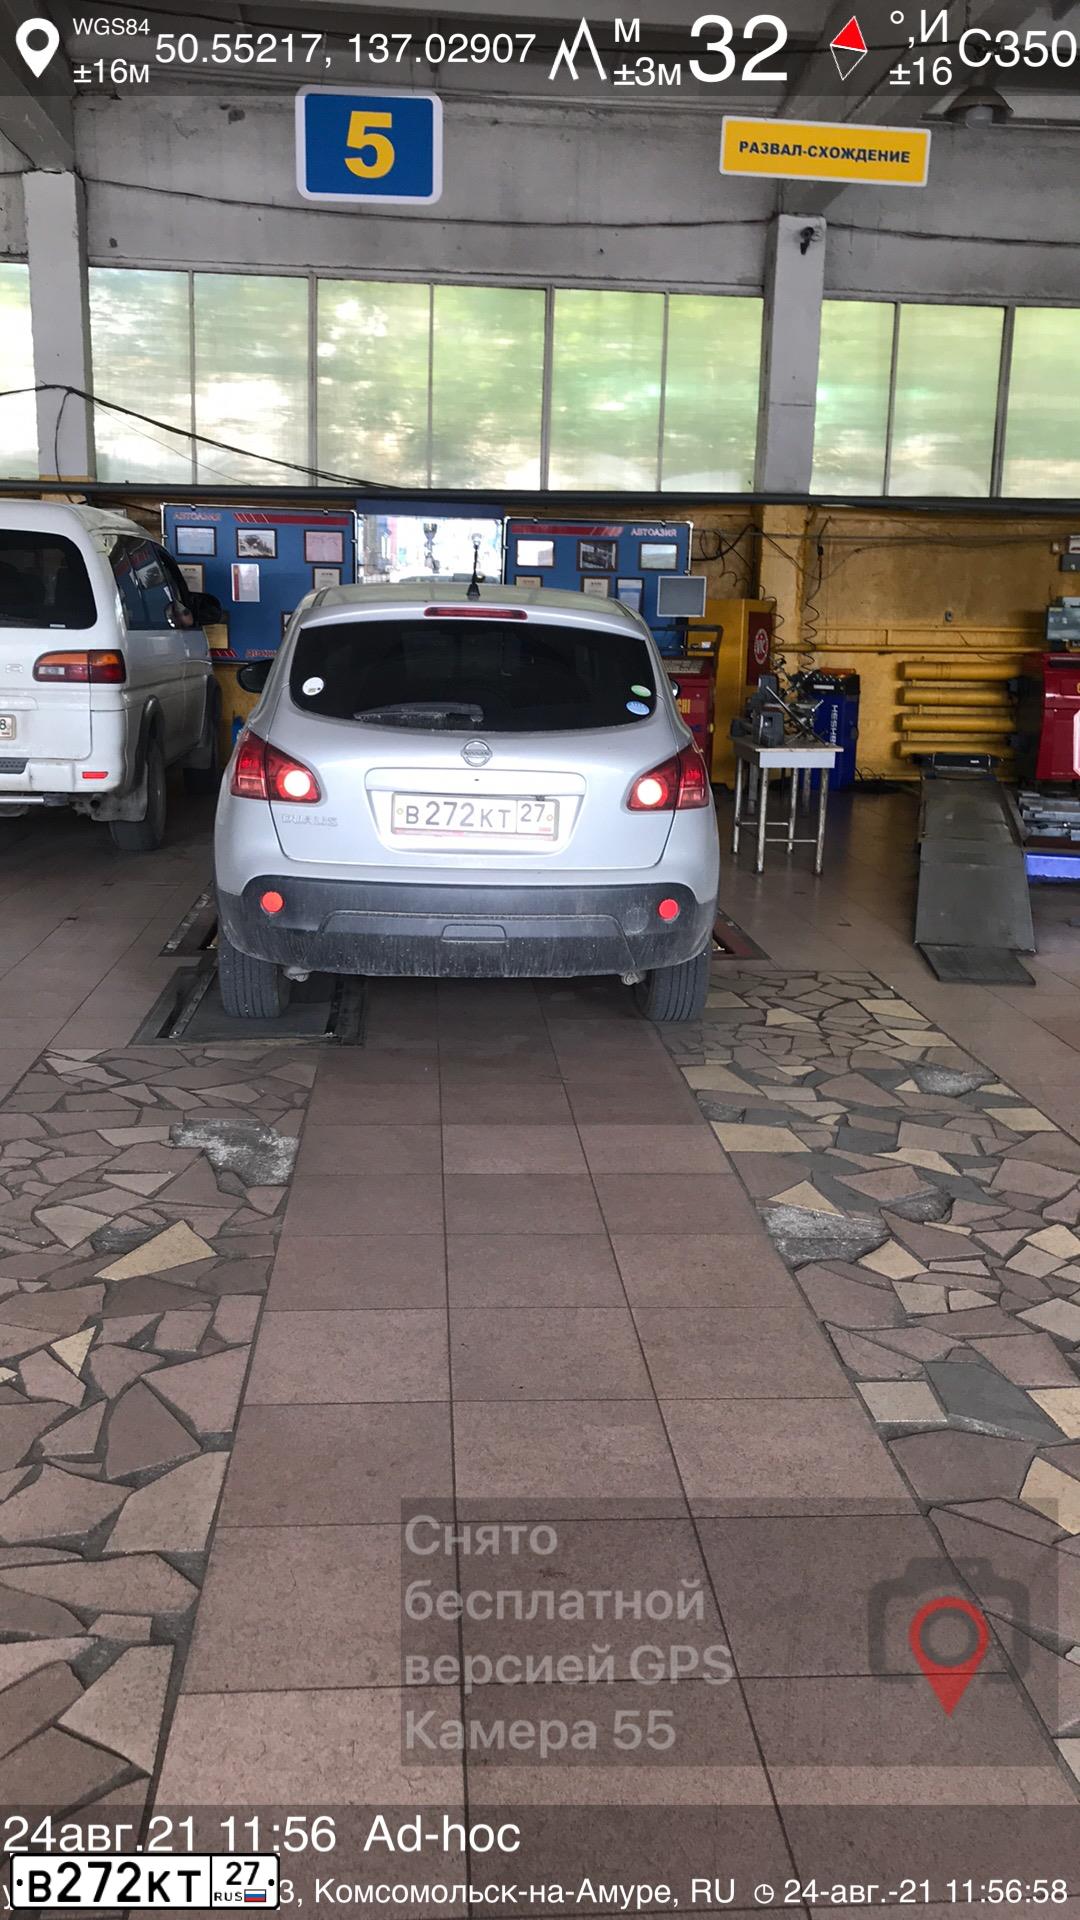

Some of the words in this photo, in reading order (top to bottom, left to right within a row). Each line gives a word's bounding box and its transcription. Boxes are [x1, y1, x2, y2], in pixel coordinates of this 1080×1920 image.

[344, 110, 395, 178] 5
[739, 140, 911, 163] РАЗВАЛ-СХОЖДЕНИЕ
[519, 803, 546, 823] 27
